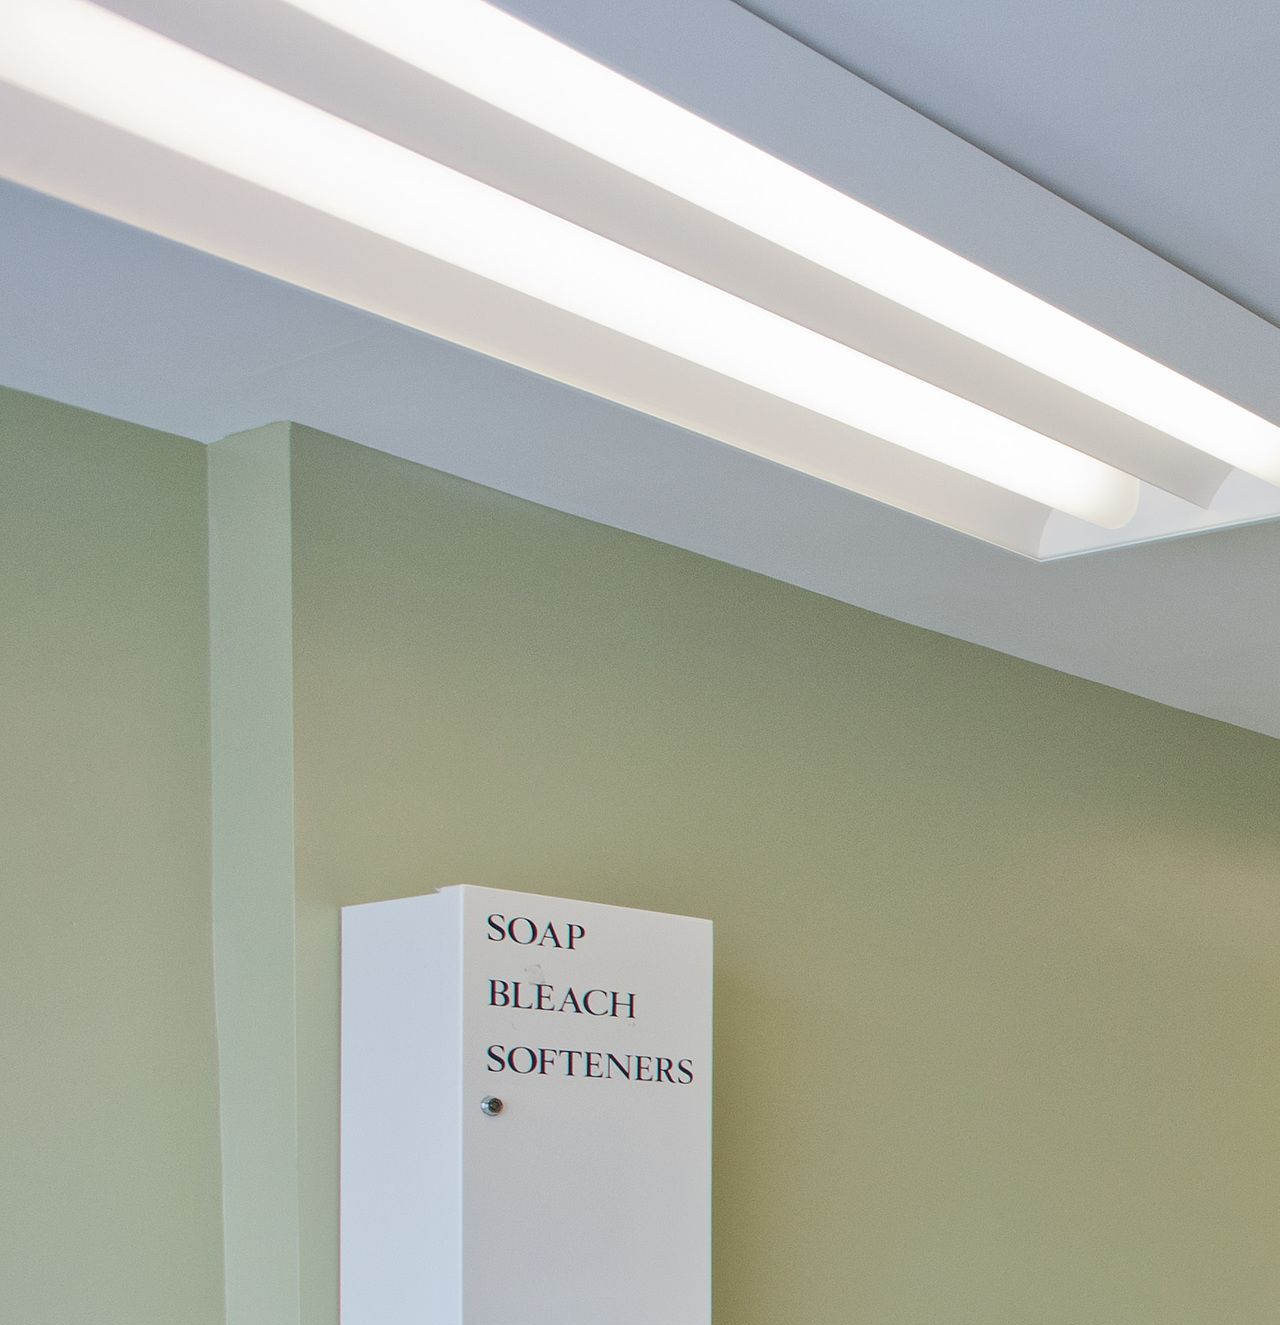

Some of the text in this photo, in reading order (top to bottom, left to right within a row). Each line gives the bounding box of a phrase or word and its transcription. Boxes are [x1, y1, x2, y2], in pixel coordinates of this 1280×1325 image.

[486, 913, 586, 950] SOAP
[488, 979, 637, 1019] BLEACH
[486, 1044, 694, 1085] SOFTENERS
